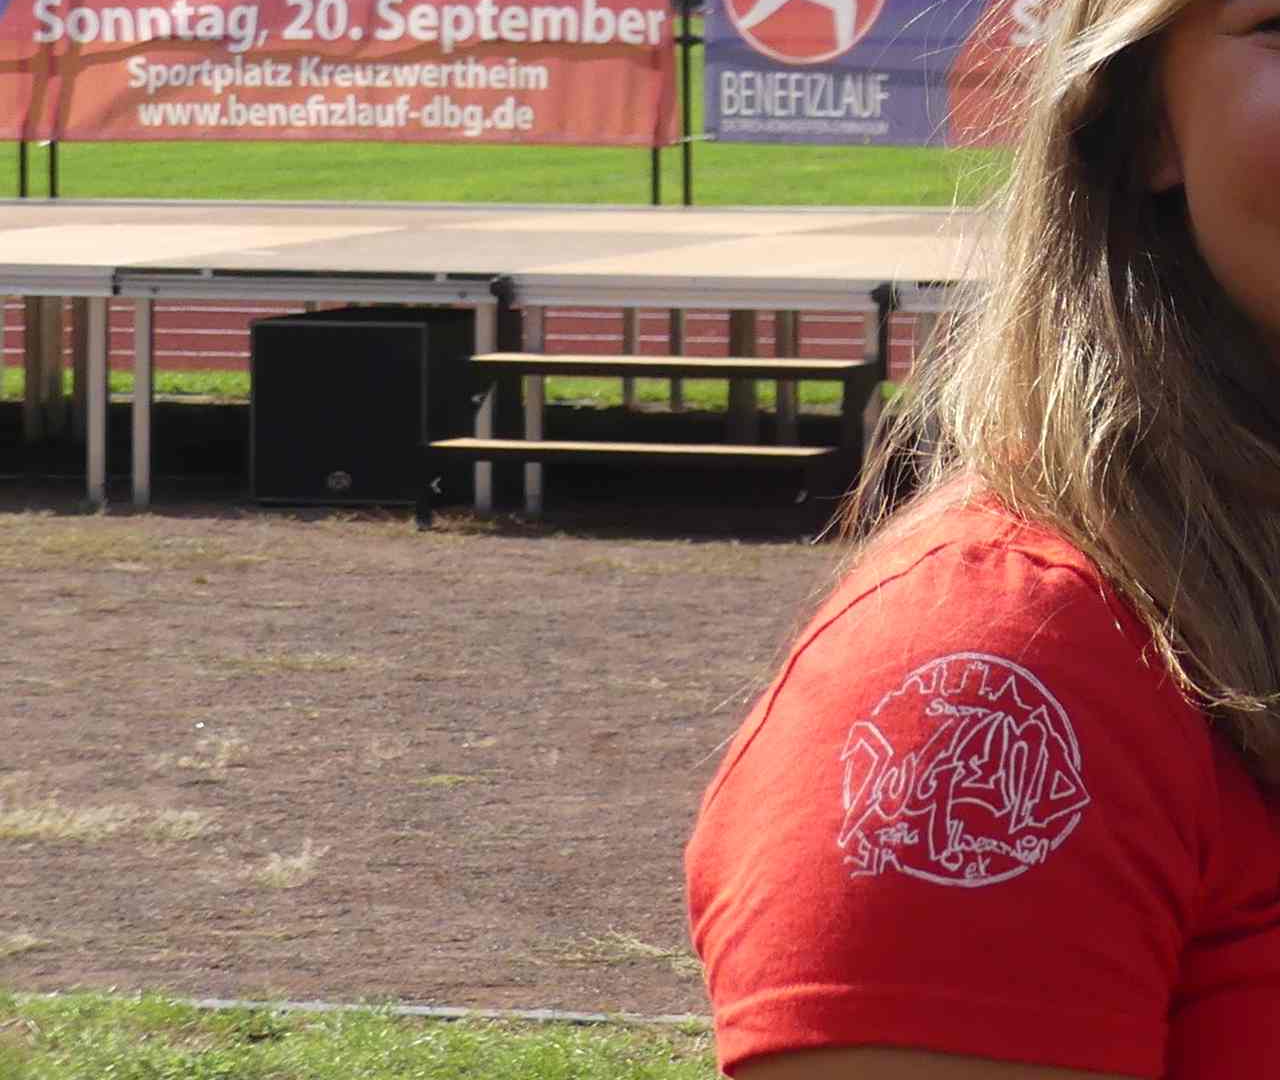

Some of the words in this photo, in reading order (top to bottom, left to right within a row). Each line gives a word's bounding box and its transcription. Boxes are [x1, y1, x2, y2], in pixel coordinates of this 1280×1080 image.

[127, 56, 292, 94] Sportplatz
[300, 58, 547, 90] Kreuzwertheim
[720, 71, 890, 118] BENEFIZLAUF
[138, 95, 533, 136] www.benefizlauf-dbg.de
